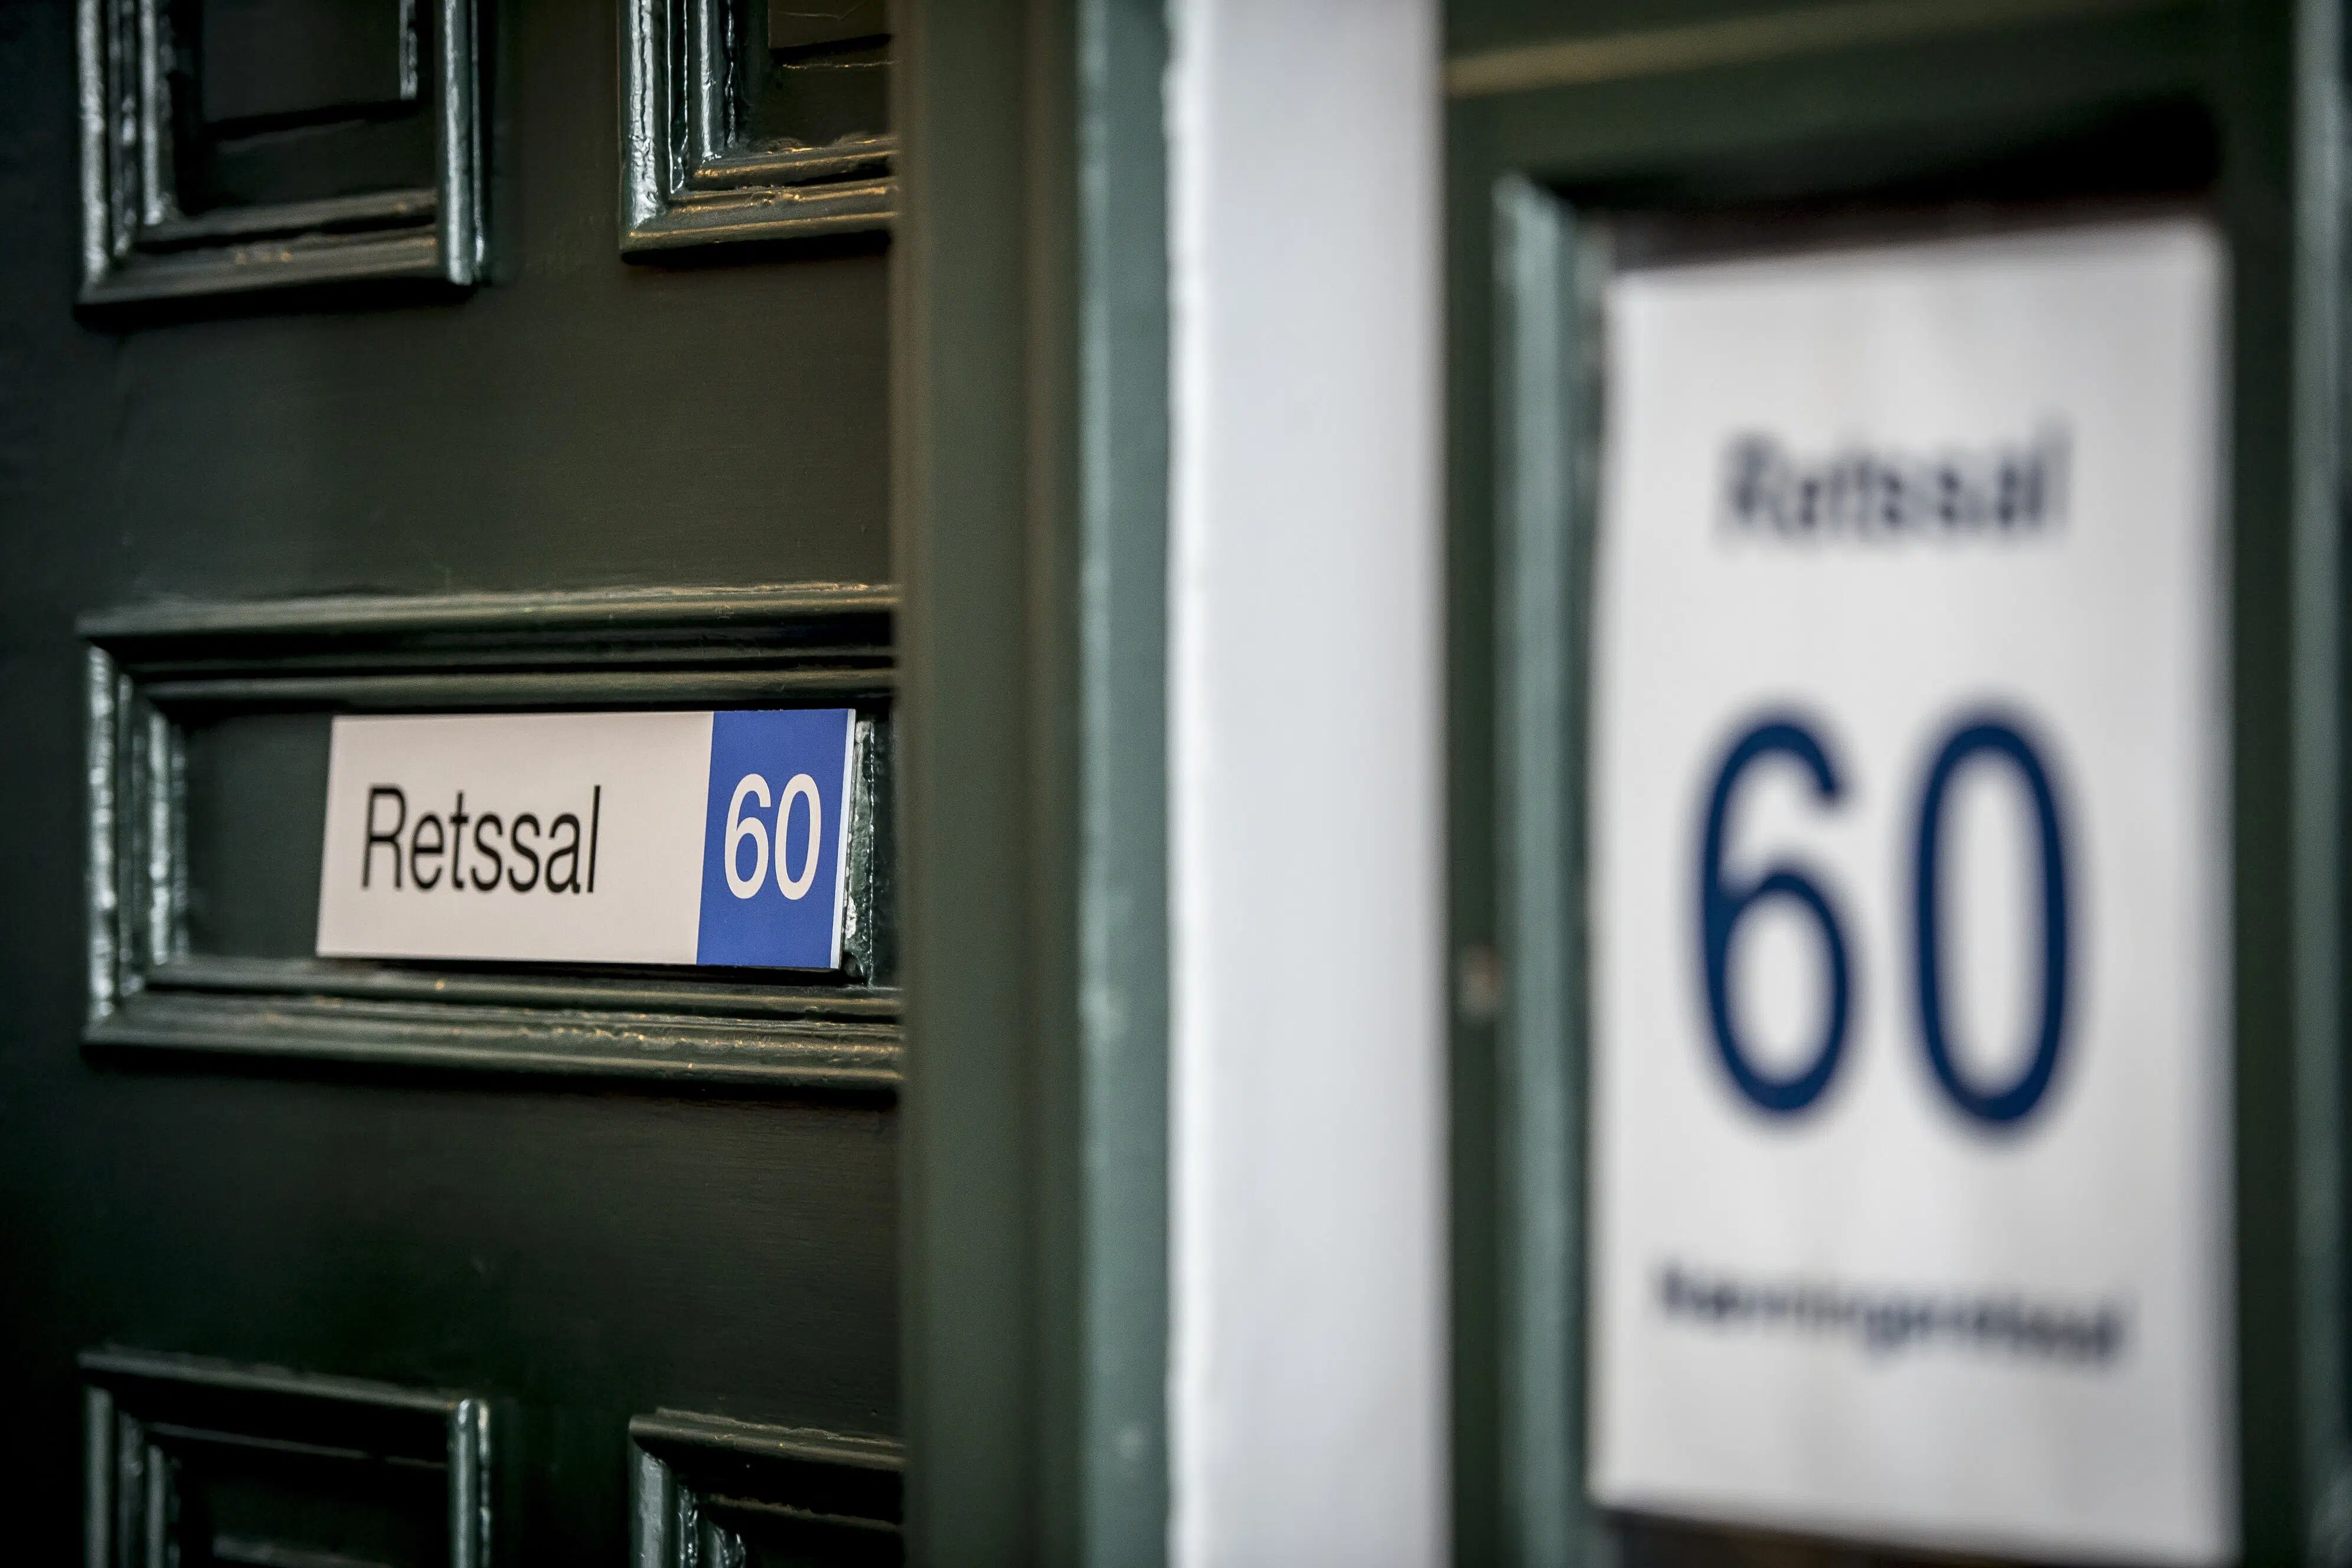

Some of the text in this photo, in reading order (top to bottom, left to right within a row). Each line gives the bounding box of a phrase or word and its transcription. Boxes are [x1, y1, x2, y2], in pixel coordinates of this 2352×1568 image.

[361, 773, 821, 900] Retssal 60
[1693, 703, 2087, 1142] 60
